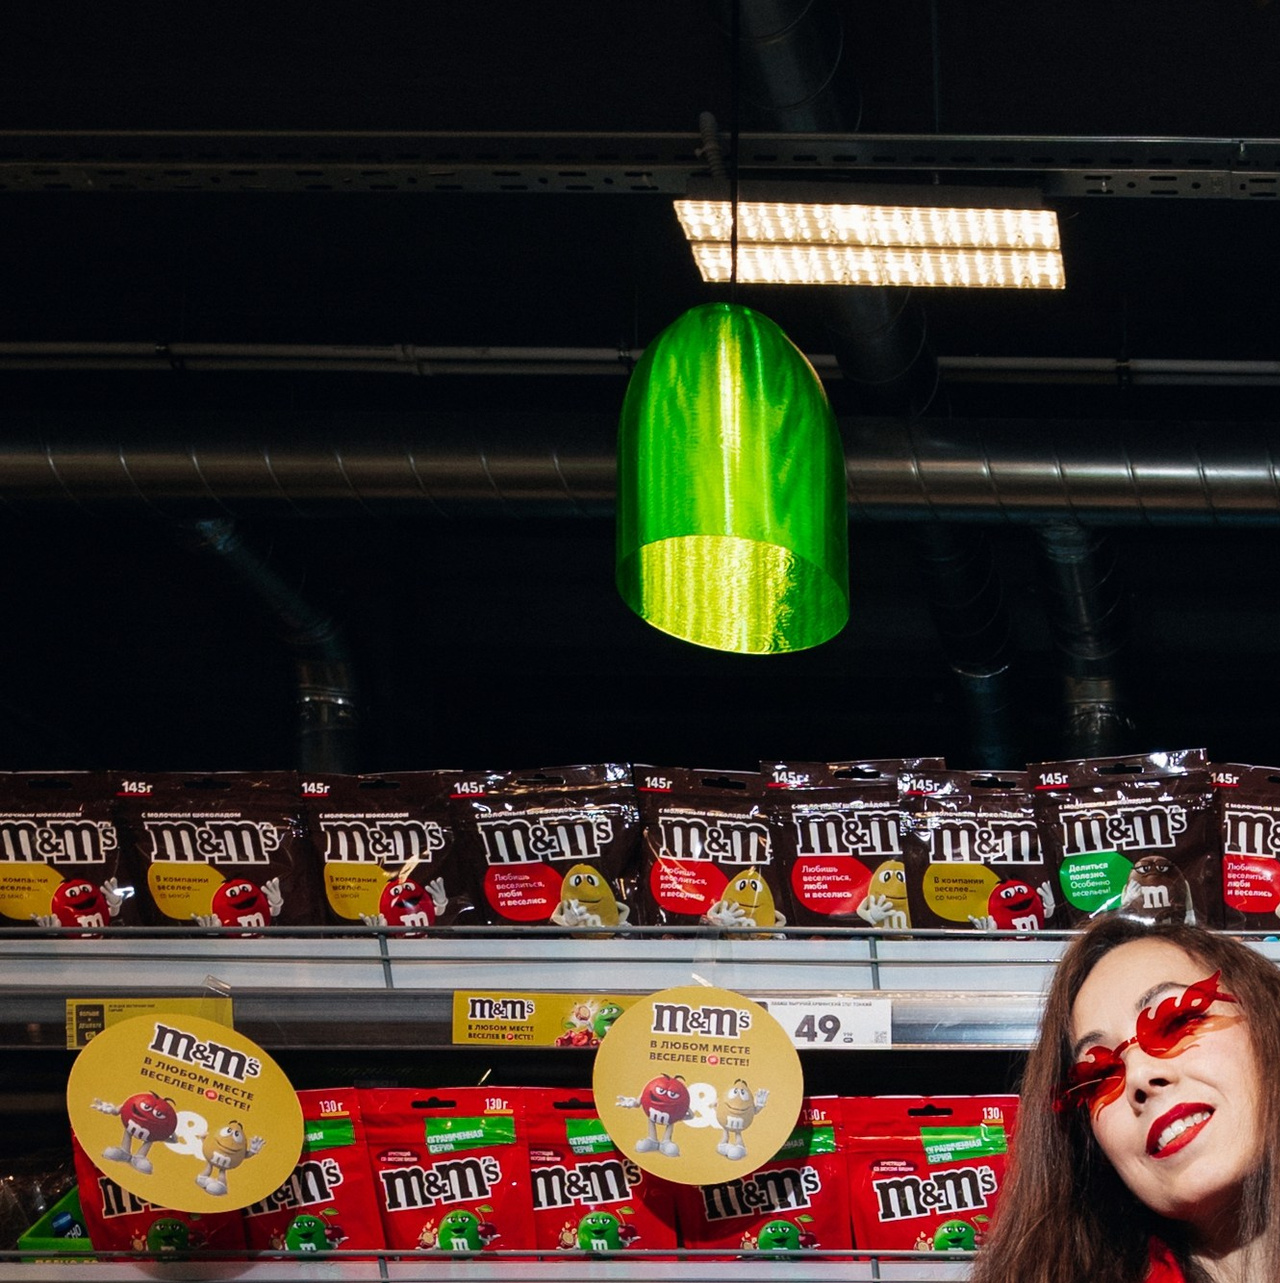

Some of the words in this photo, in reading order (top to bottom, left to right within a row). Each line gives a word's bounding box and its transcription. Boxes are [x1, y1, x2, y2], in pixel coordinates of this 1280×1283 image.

[645, 776, 672, 790] 145г
[1040, 773, 1068, 786] 145г
[122, 782, 152, 793] 145г
[302, 783, 330, 794] 145г
[454, 781, 485, 794] 145г
[794, 1014, 841, 1043] 49
[651, 1040, 657, 1048] В
[661, 1042, 709, 1051] ЛЮБОМ
[713, 1045, 750, 1054] МЕСТЕ
[650, 1053, 698, 1063] ВЕСЕЛЕЕ
[140, 1068, 195, 1094] ВЕСЕЛЕЕ
[144, 1057, 151, 1065] В
[155, 1060, 209, 1084] ЛЮБОМ
[213, 1079, 254, 1100] МЕСТЕ
